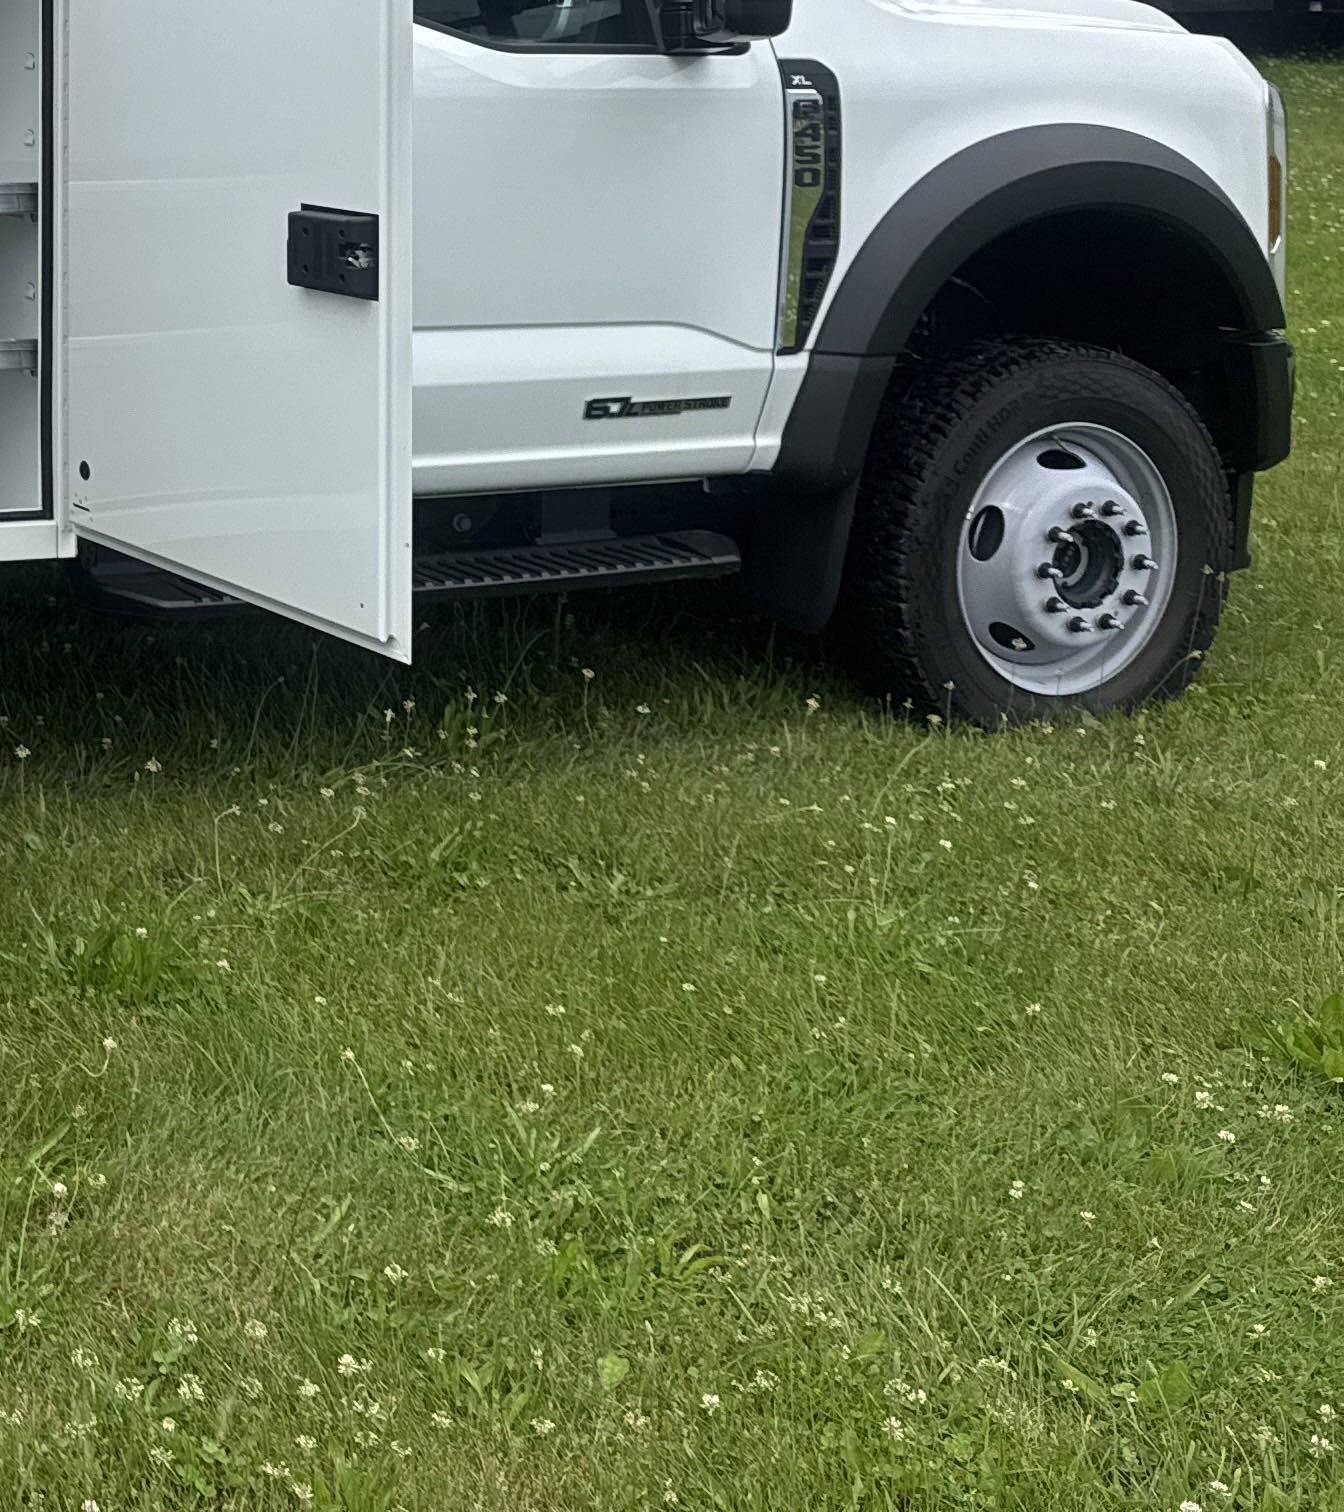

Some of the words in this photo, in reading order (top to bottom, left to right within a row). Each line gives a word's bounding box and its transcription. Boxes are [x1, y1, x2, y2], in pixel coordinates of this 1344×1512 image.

[791, 74, 812, 86] XL
[641, 401, 681, 413] POWER
[683, 397, 730, 410] STROKE
